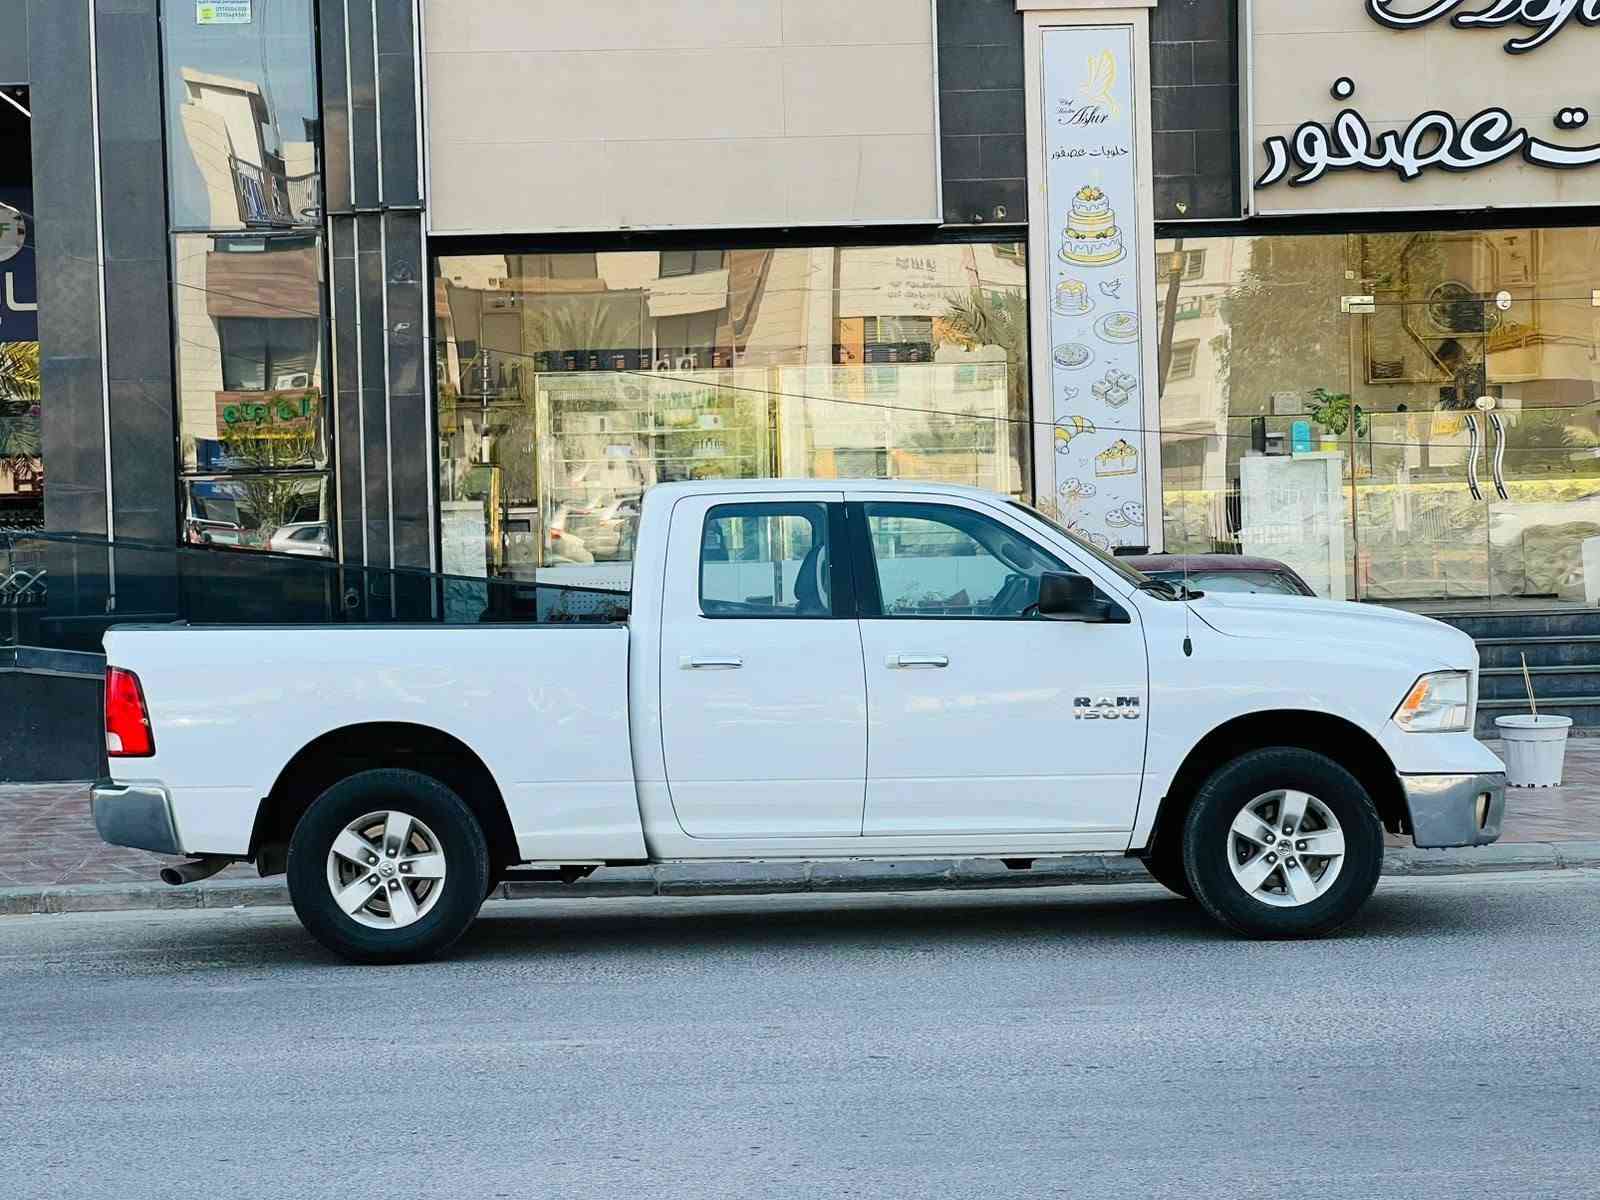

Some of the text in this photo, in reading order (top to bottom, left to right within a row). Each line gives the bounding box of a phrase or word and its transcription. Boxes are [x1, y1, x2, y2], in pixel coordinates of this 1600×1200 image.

[1254, 76, 1528, 188] عصفور
[1051, 144, 1128, 160] حلويات عصفور
[1073, 696, 1140, 708] RAM
[1072, 708, 1140, 720] 1500
